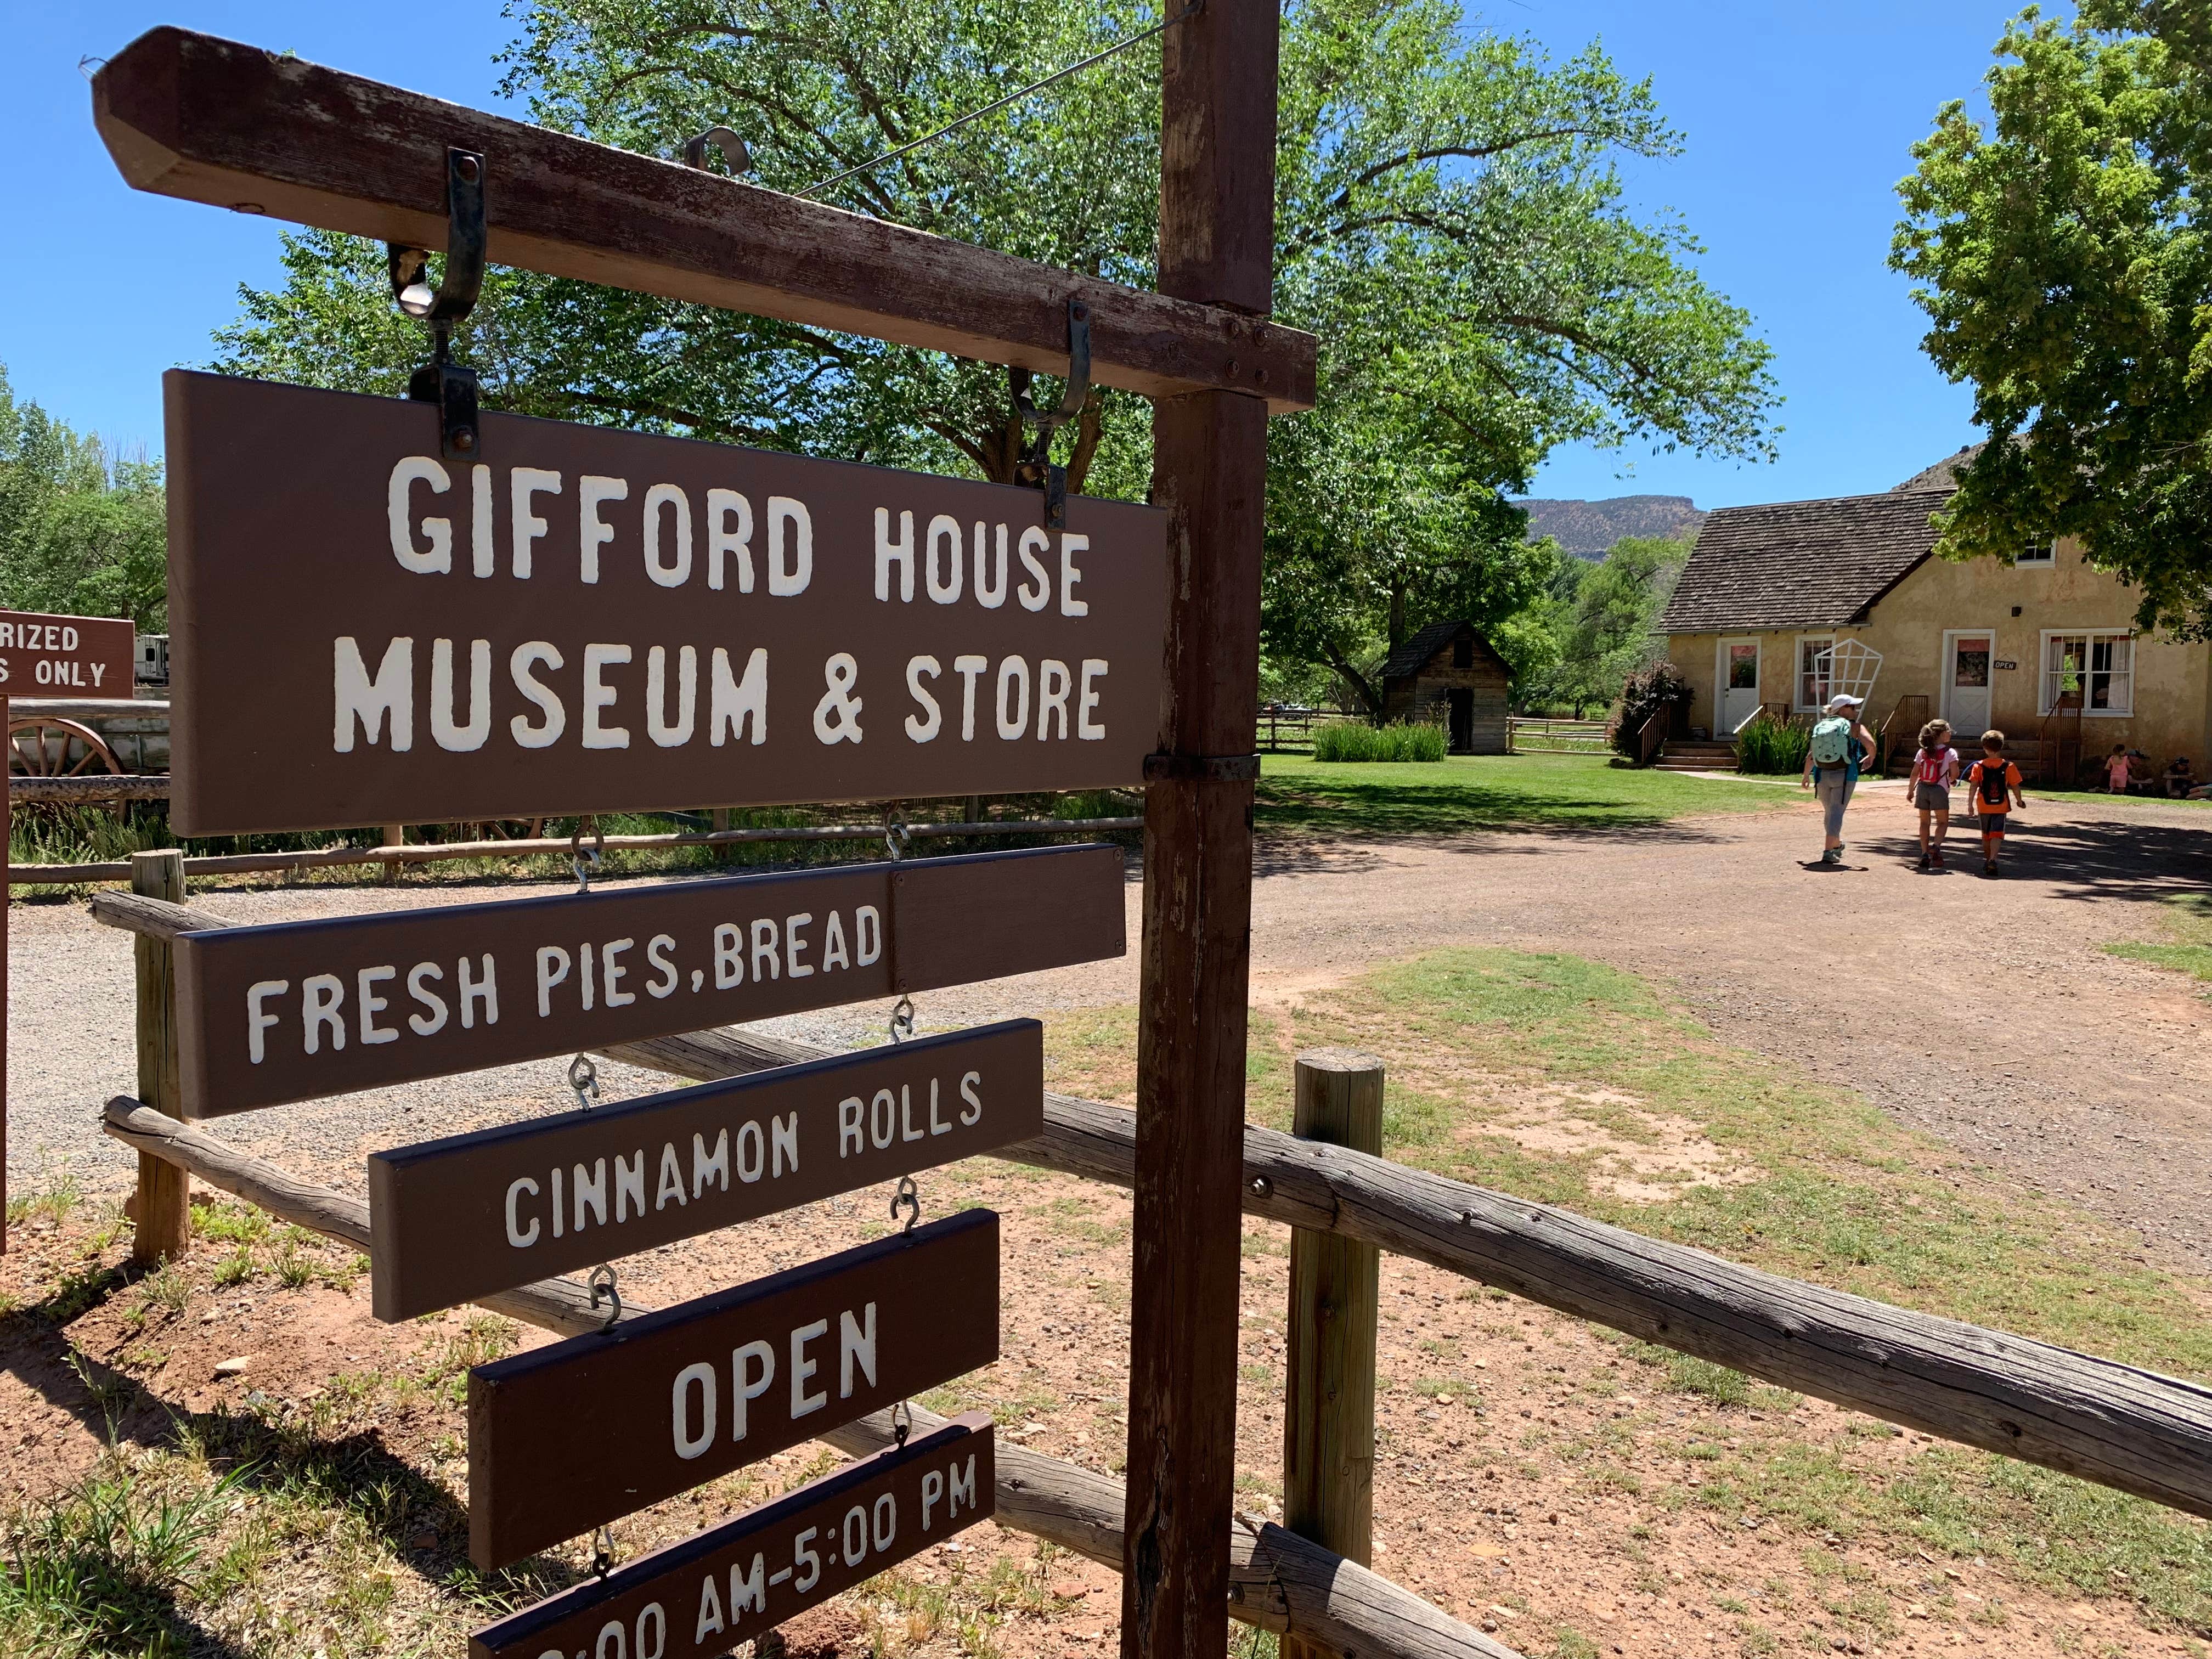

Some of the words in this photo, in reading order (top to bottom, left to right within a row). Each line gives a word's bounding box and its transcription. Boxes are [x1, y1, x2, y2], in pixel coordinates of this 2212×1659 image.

[387, 455, 814, 597] GIFFORD
[874, 506, 1090, 617] HOUSE
[35, 660, 106, 687] ONLY
[333, 636, 769, 753] MUSEUM
[812, 652, 864, 746] &
[904, 654, 1109, 744] STORE
[246, 952, 499, 1064] FRESH
[505, 1110, 799, 1248] CINNAMON
[838, 1071, 982, 1159] ROLLS
[673, 1300, 877, 1460] OPEN
[537, 1601, 666, 1659] 00
[921, 1454, 977, 1532] PM
